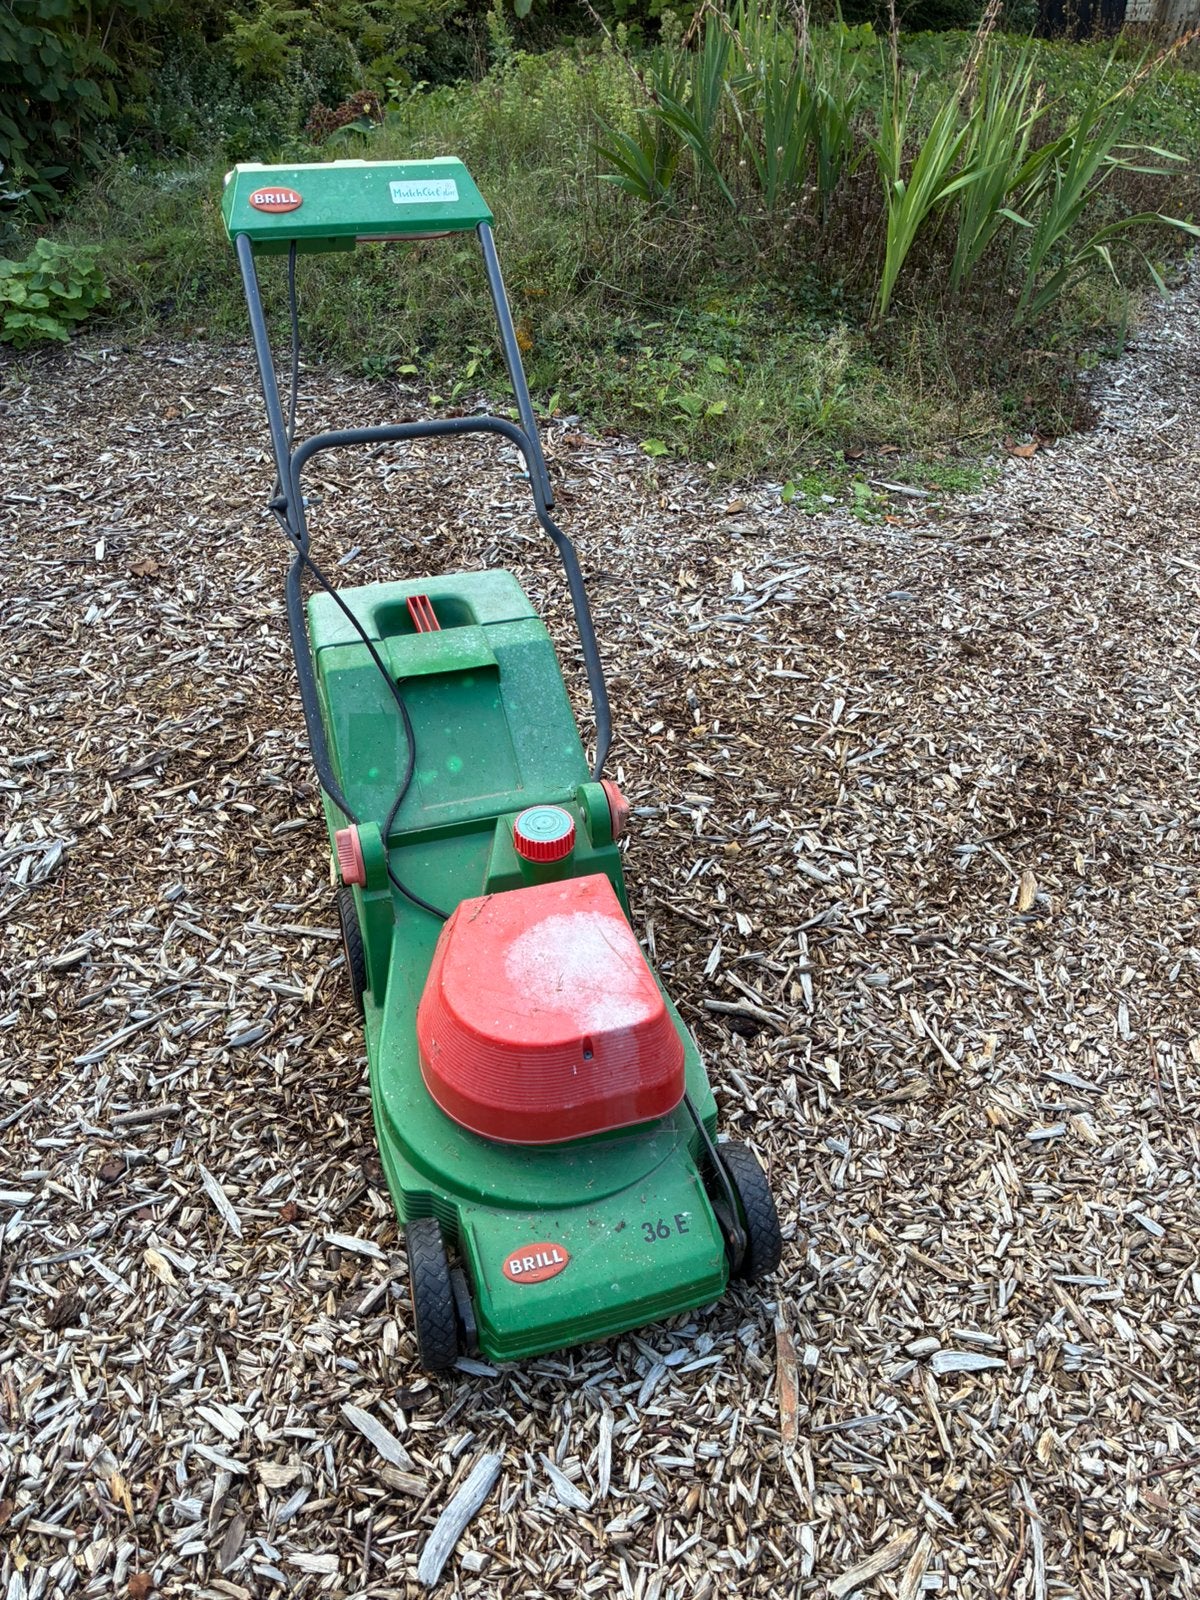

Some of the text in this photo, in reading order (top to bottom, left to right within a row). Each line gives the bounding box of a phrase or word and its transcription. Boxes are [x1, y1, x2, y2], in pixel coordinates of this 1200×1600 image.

[254, 192, 298, 204] BRILL
[641, 1213, 690, 1243] 36 E
[509, 1249, 564, 1276] BRILL
